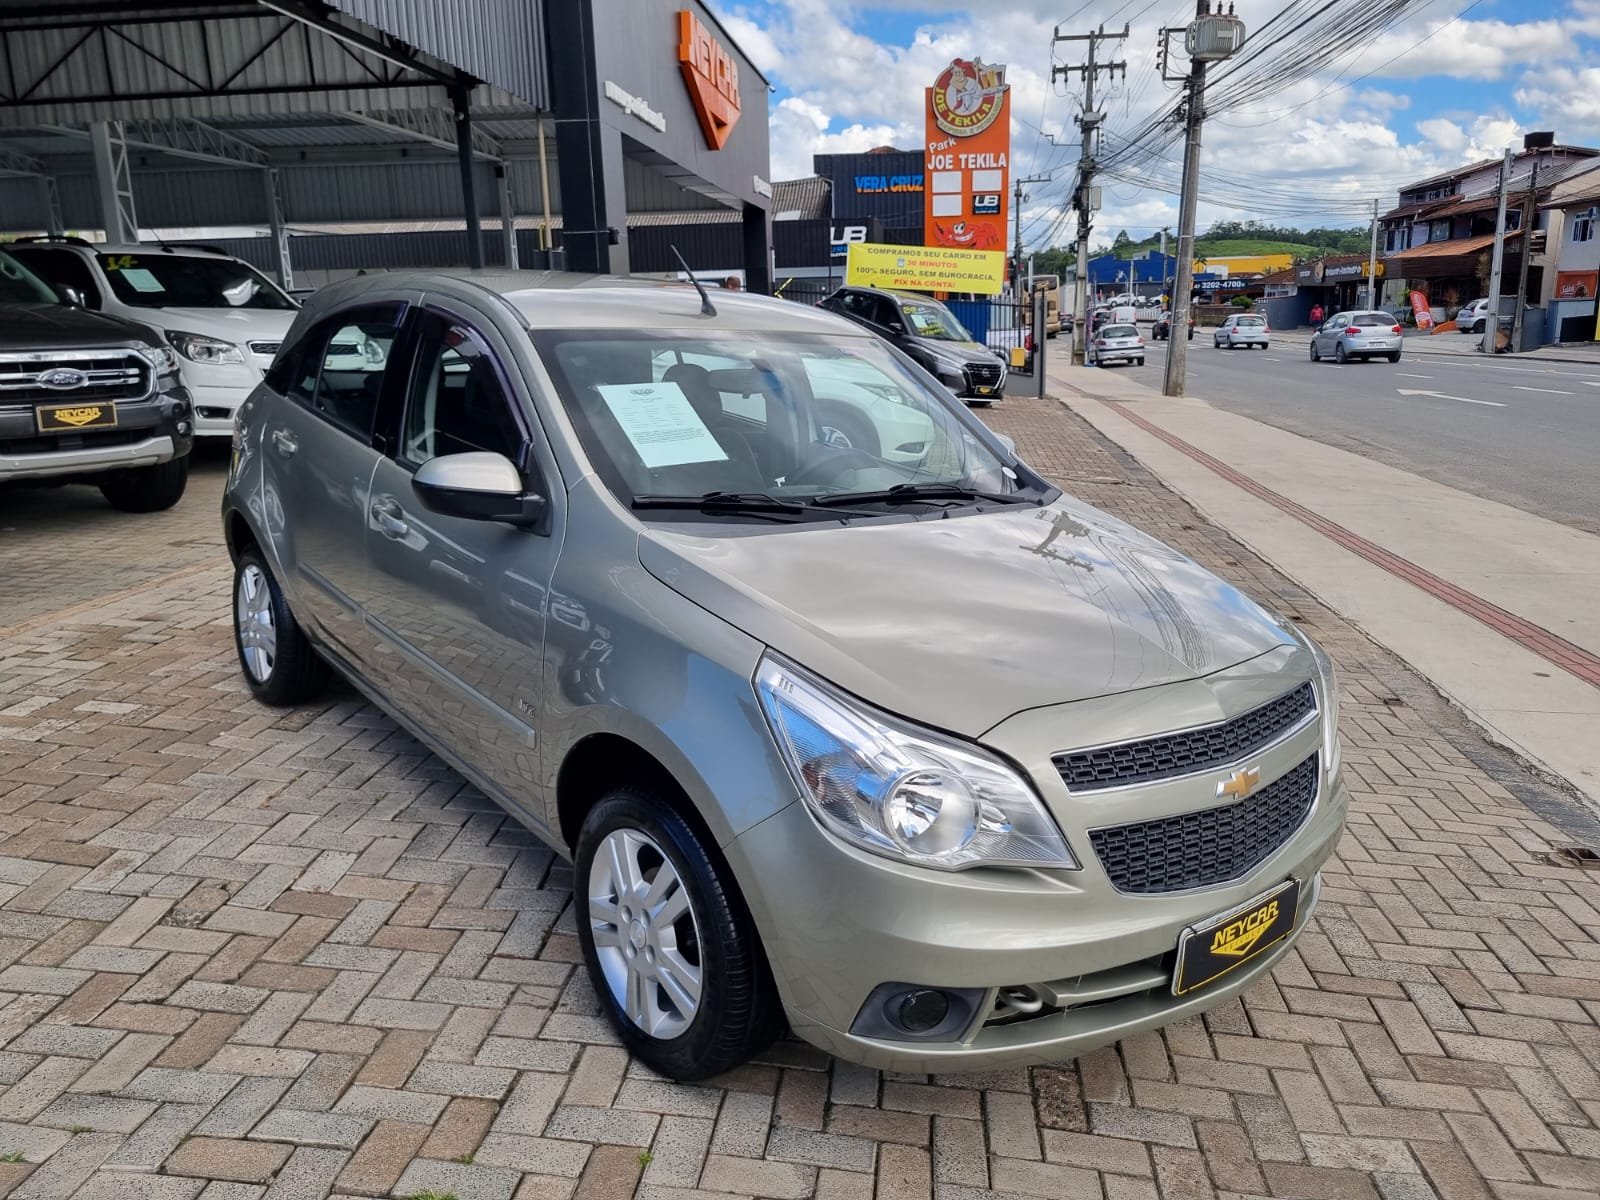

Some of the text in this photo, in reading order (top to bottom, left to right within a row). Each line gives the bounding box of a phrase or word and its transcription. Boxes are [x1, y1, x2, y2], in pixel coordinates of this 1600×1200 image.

[680, 11, 741, 110] NEYCAR
[935, 87, 992, 126] JOE TEKILA
[929, 137, 957, 154] Park
[928, 152, 1007, 170] JOE TEKILA
[855, 174, 924, 193] VERA CRUZ
[867, 247, 921, 257] COMPRAMOS
[942, 252, 972, 260] CARRO
[856, 266, 878, 275] 100%
[879, 268, 917, 277] SEGURO,
[919, 270, 937, 278] SEM
[919, 261, 958, 269] MINUTOS
[894, 278, 909, 286] PIX
[924, 281, 956, 289] CONTA!
[54, 407, 102, 418] NEYCAR
[1210, 900, 1279, 951] NEYCAR
